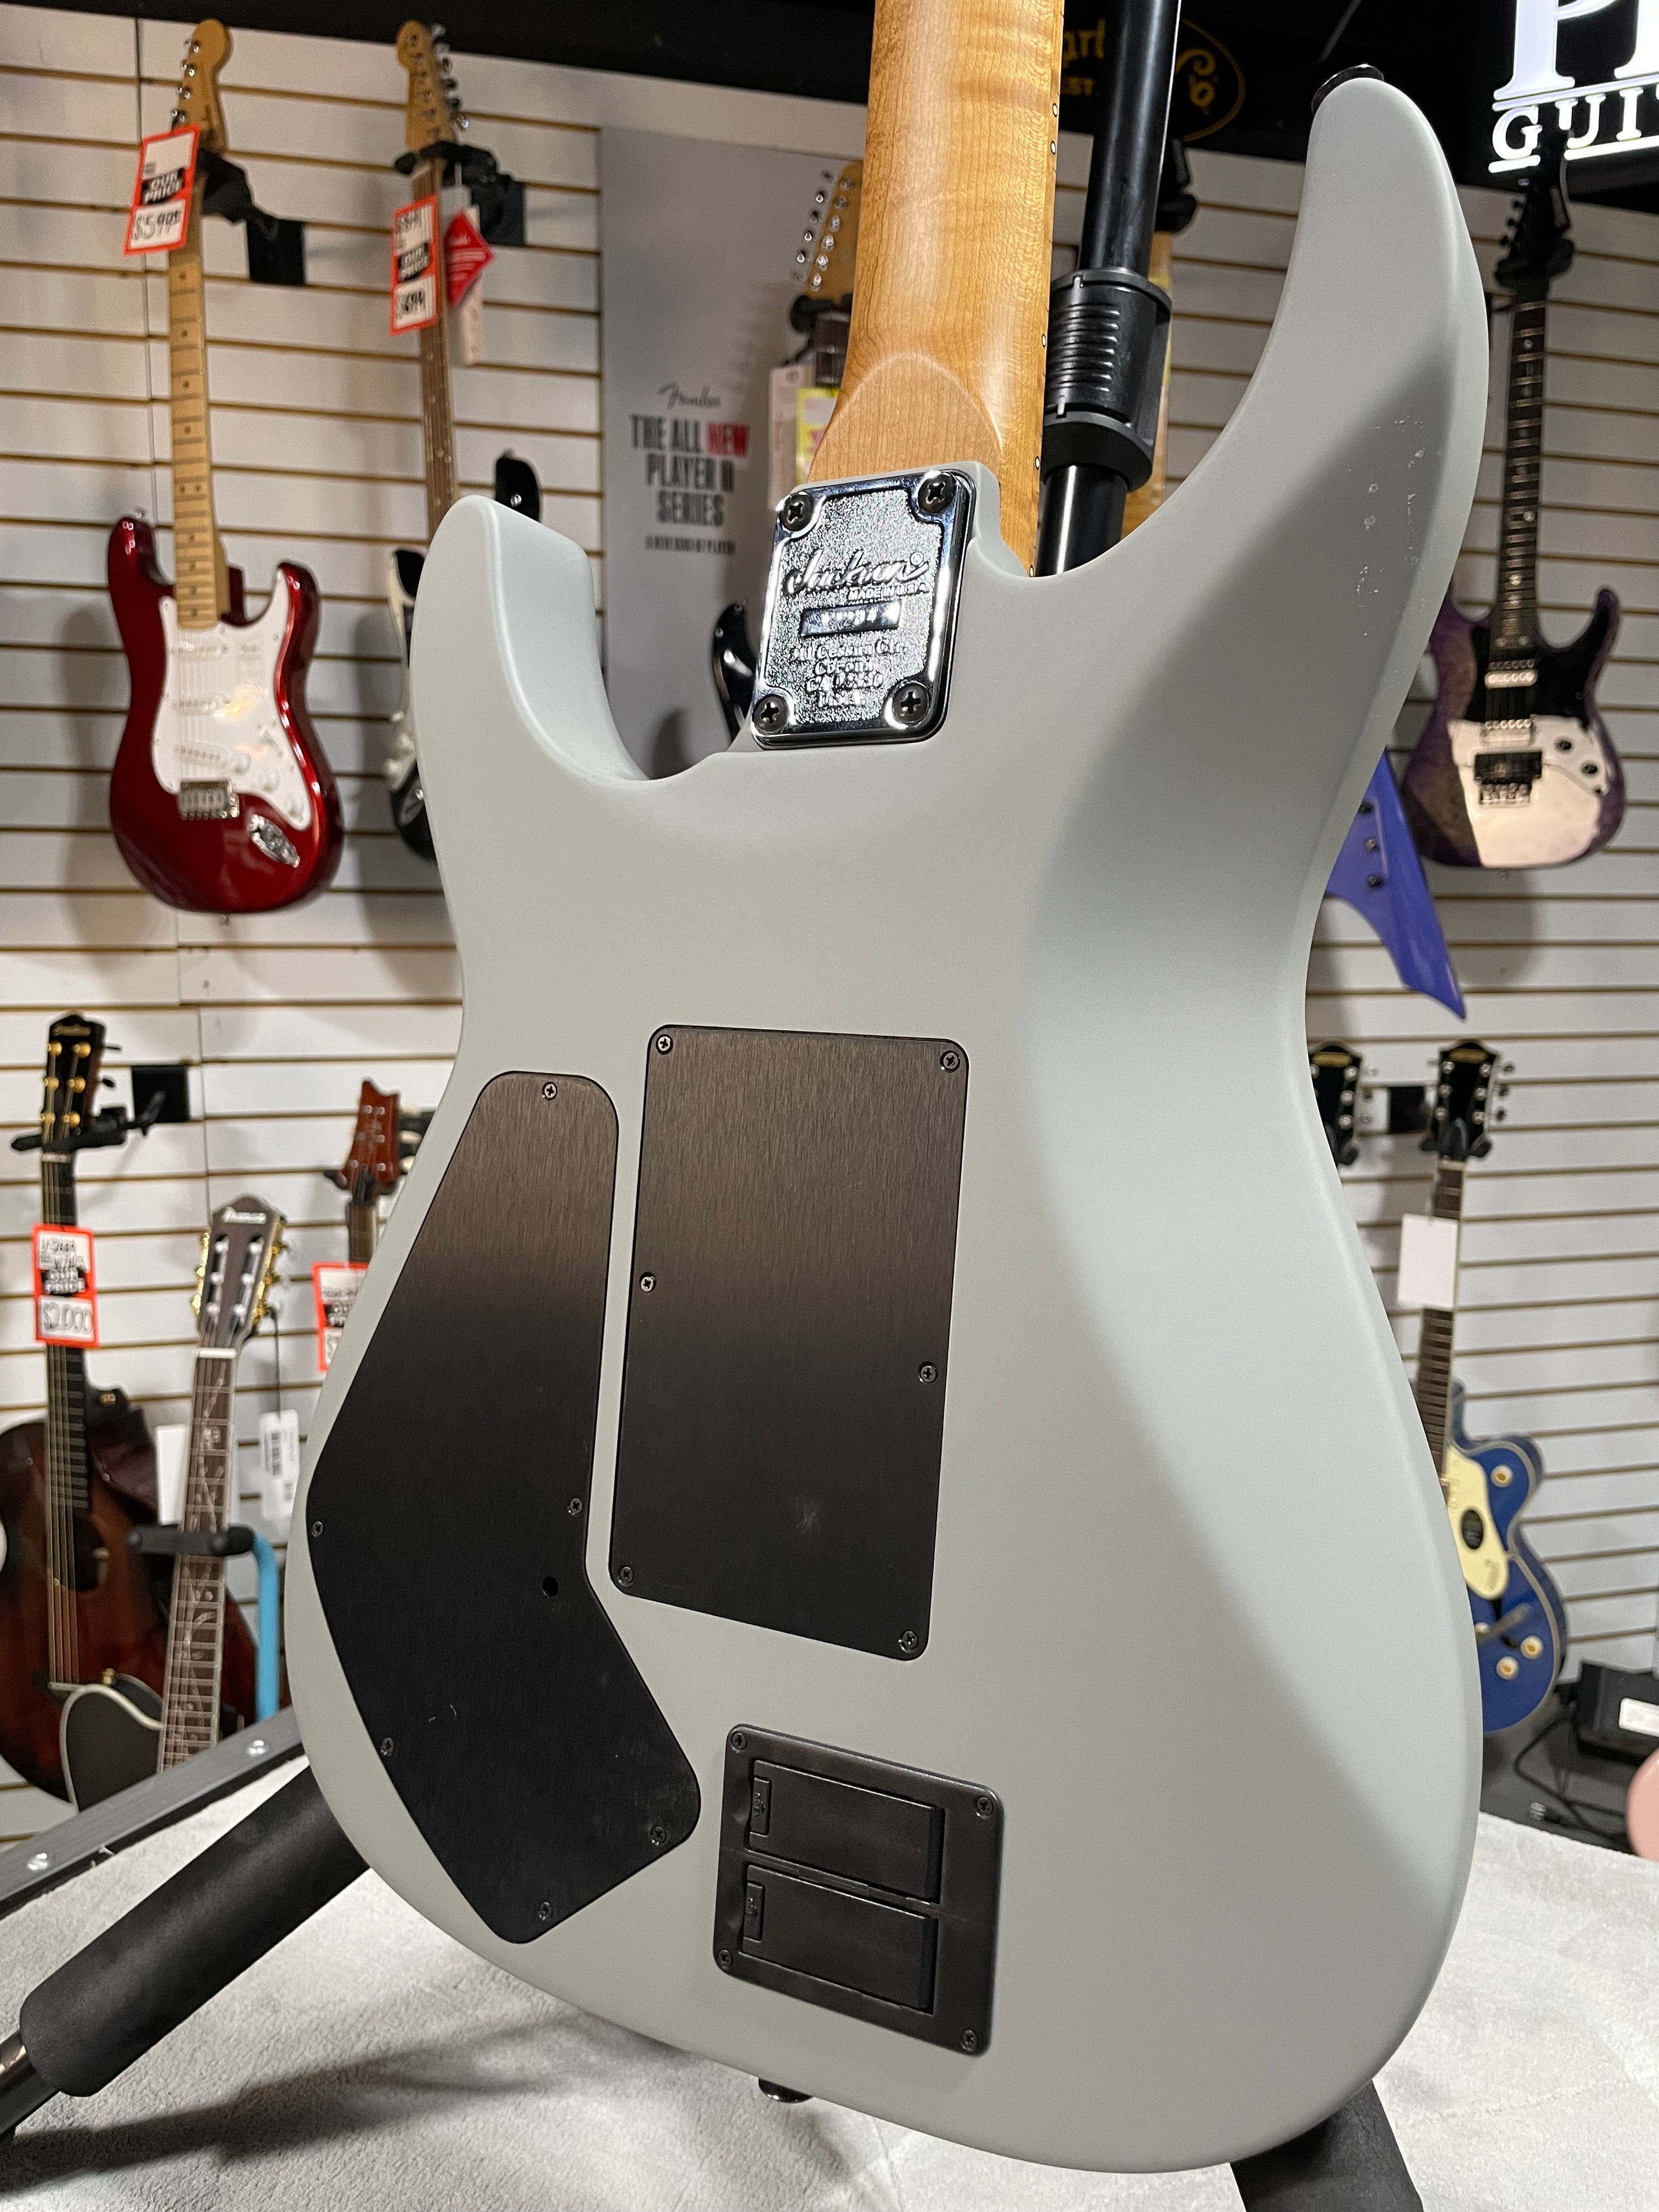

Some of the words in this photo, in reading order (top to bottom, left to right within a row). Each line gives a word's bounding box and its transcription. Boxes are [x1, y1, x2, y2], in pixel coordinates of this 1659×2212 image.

[631, 415, 665, 451] THE
[670, 419, 702, 454] ALL
[708, 422, 749, 458] NEW
[646, 453, 715, 490] PLAYER
[658, 490, 724, 526] SERIES
[848, 586, 881, 601] MADE
[882, 585, 894, 599] IN
